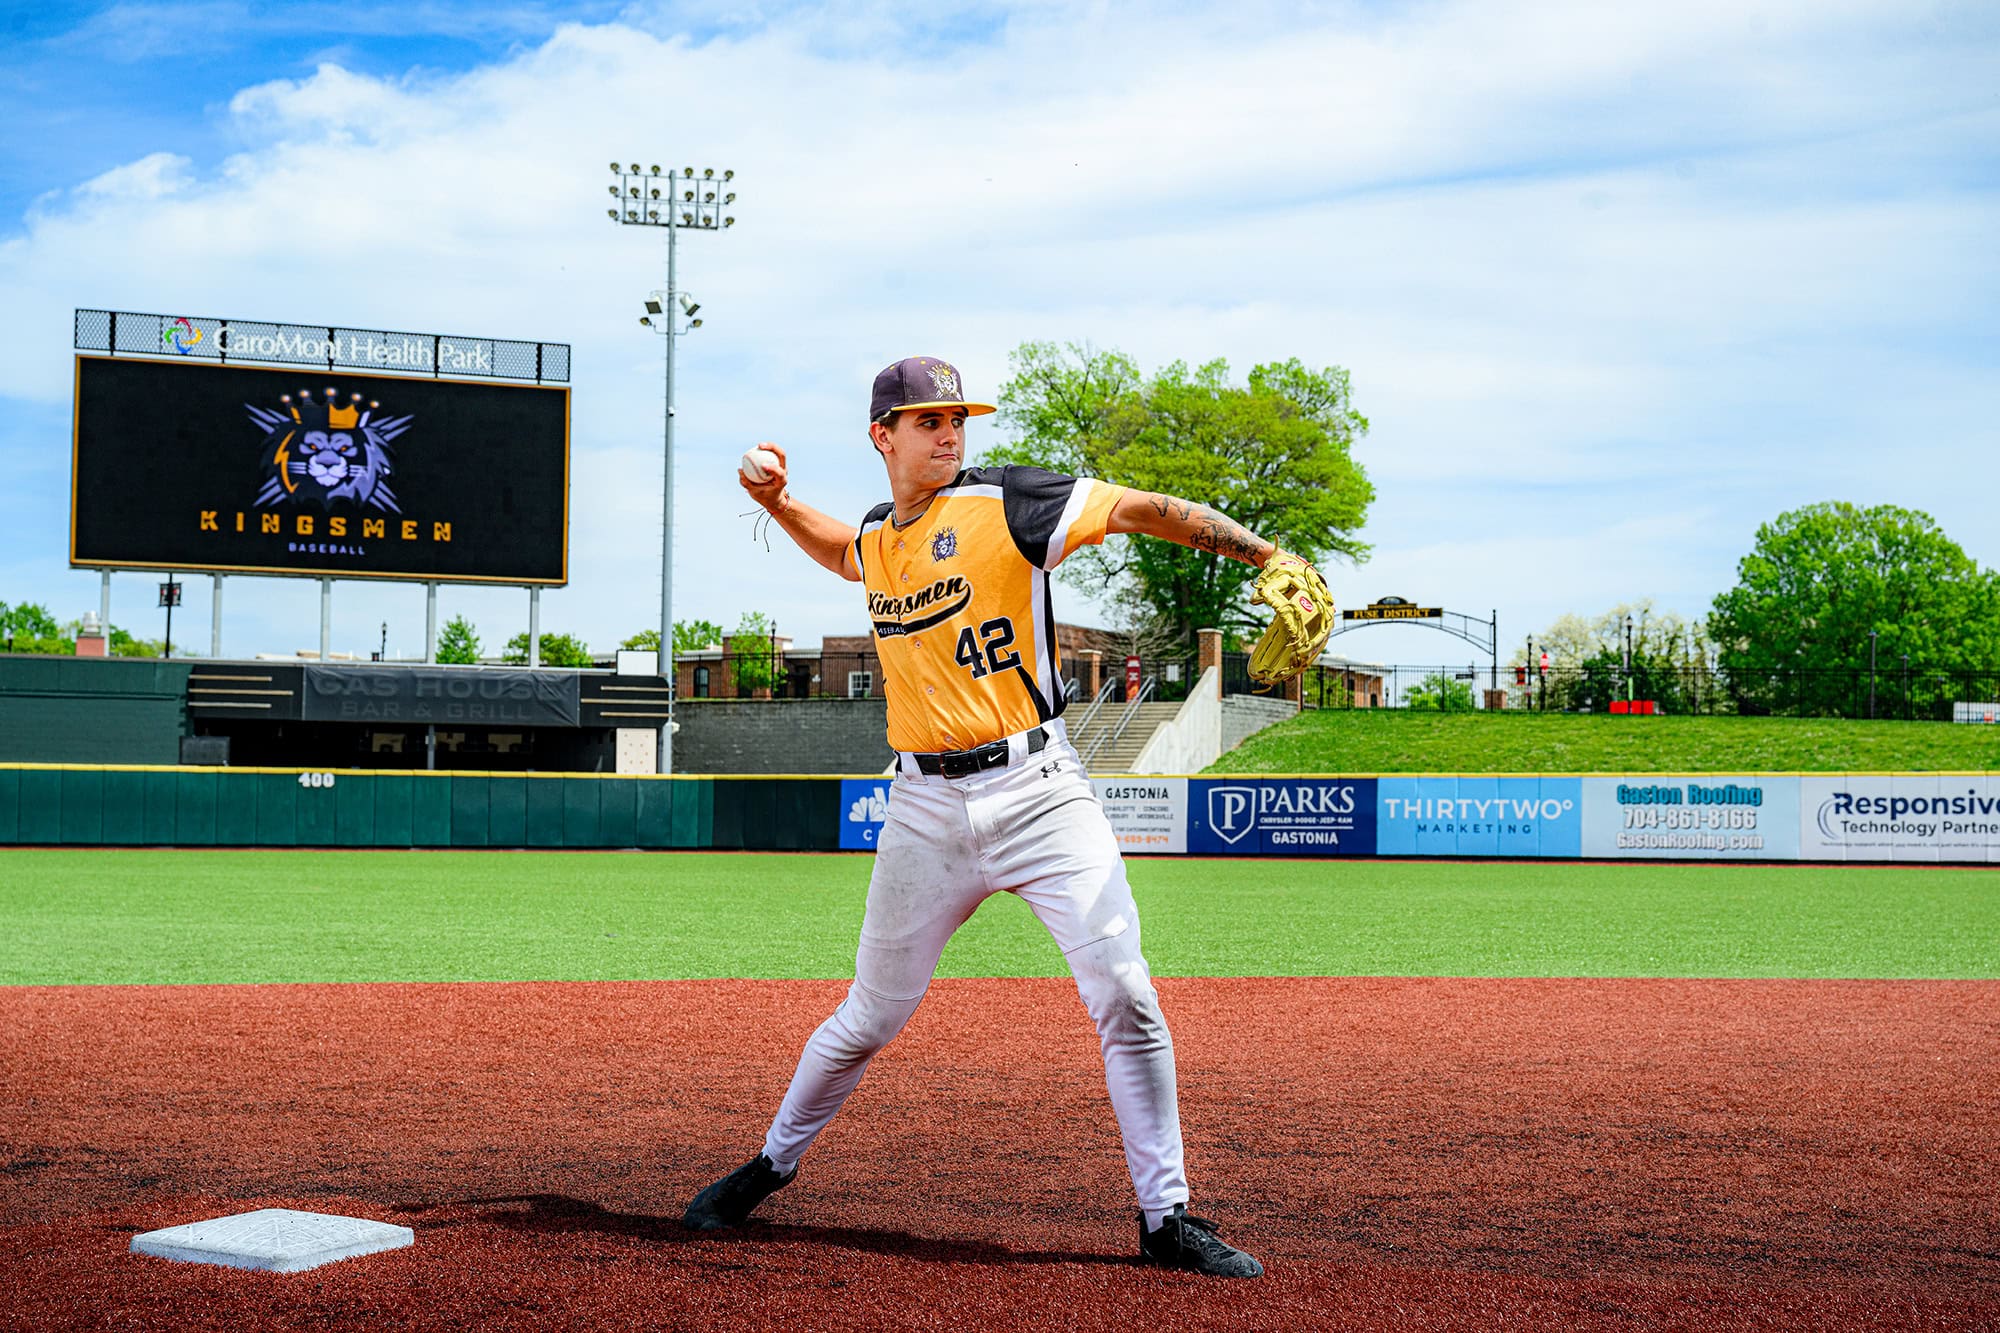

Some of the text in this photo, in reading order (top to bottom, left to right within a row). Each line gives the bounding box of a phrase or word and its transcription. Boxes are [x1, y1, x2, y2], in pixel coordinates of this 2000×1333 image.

[213, 326, 490, 370] CaroMont Health Park
[200, 510, 452, 542] KINGSMEN
[288, 542, 365, 555] BASEBALL
[1353, 608, 1430, 619] FUSE DISTRICT
[955, 616, 1021, 680] 42
[313, 674, 546, 701] GAS HOUS
[341, 701, 533, 720] BAR & GRILL
[298, 772, 335, 787] 400
[1105, 787, 1169, 800] GASTONIA
[1259, 786, 1355, 814] PARKS
[1617, 784, 1763, 807] Gaston Roofing
[1220, 793, 1246, 830] P
[1623, 807, 1757, 829] 704-861-8166
[1271, 831, 1339, 844] GASTONIA
[1416, 823, 1532, 834] MARKETING
[1840, 820, 1937, 837] Technology
[1616, 831, 1764, 851] GastonRoofing.com
